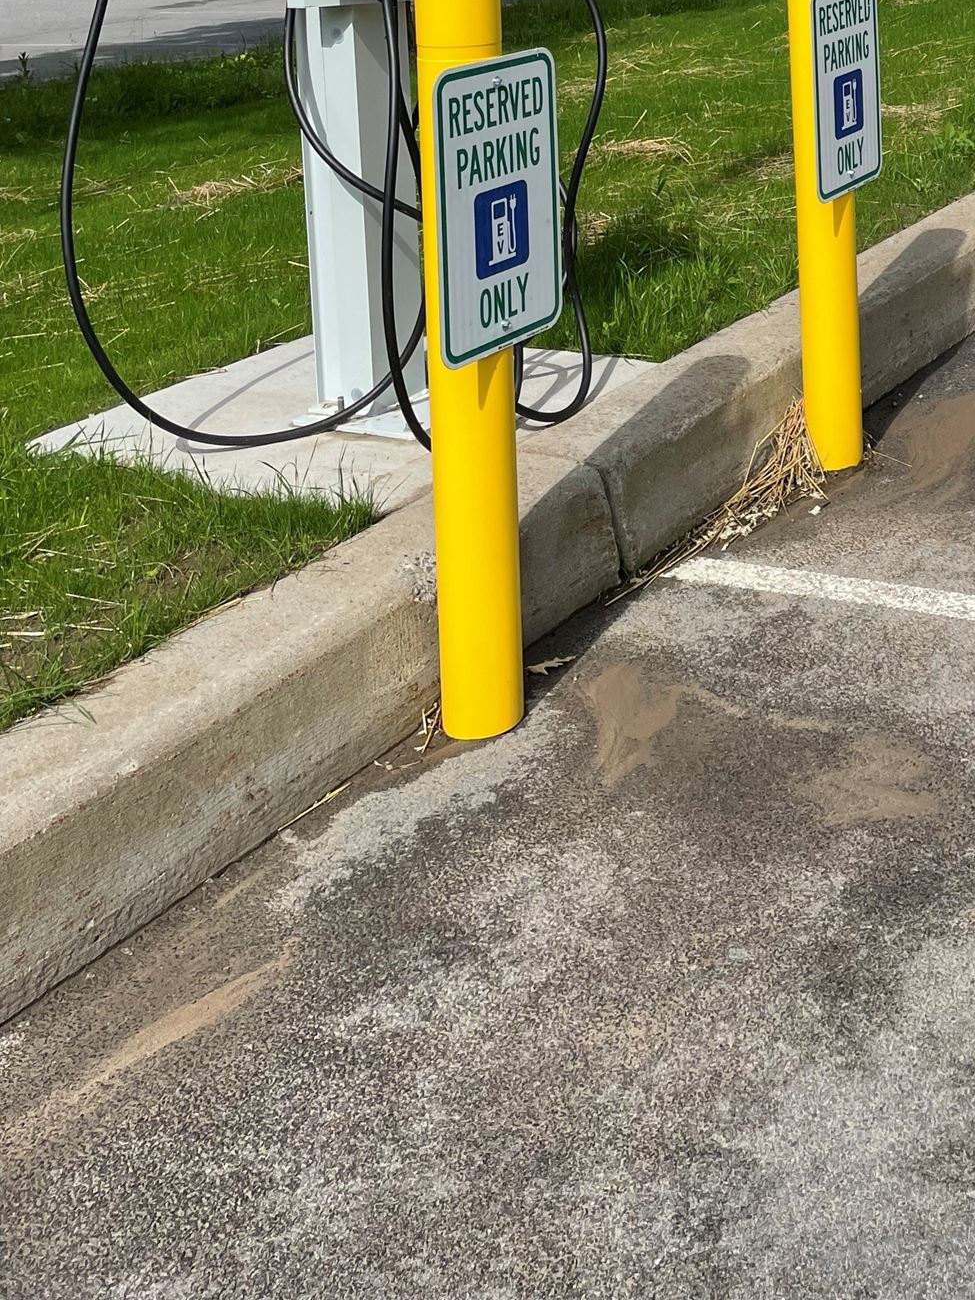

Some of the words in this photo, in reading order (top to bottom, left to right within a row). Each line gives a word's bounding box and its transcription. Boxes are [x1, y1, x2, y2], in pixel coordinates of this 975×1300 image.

[823, 30, 870, 74] PARKING
[448, 76, 543, 139] RESERVED
[456, 127, 540, 190] PARKING
[837, 136, 865, 176] ONLY
[479, 272, 529, 329] ONLY
